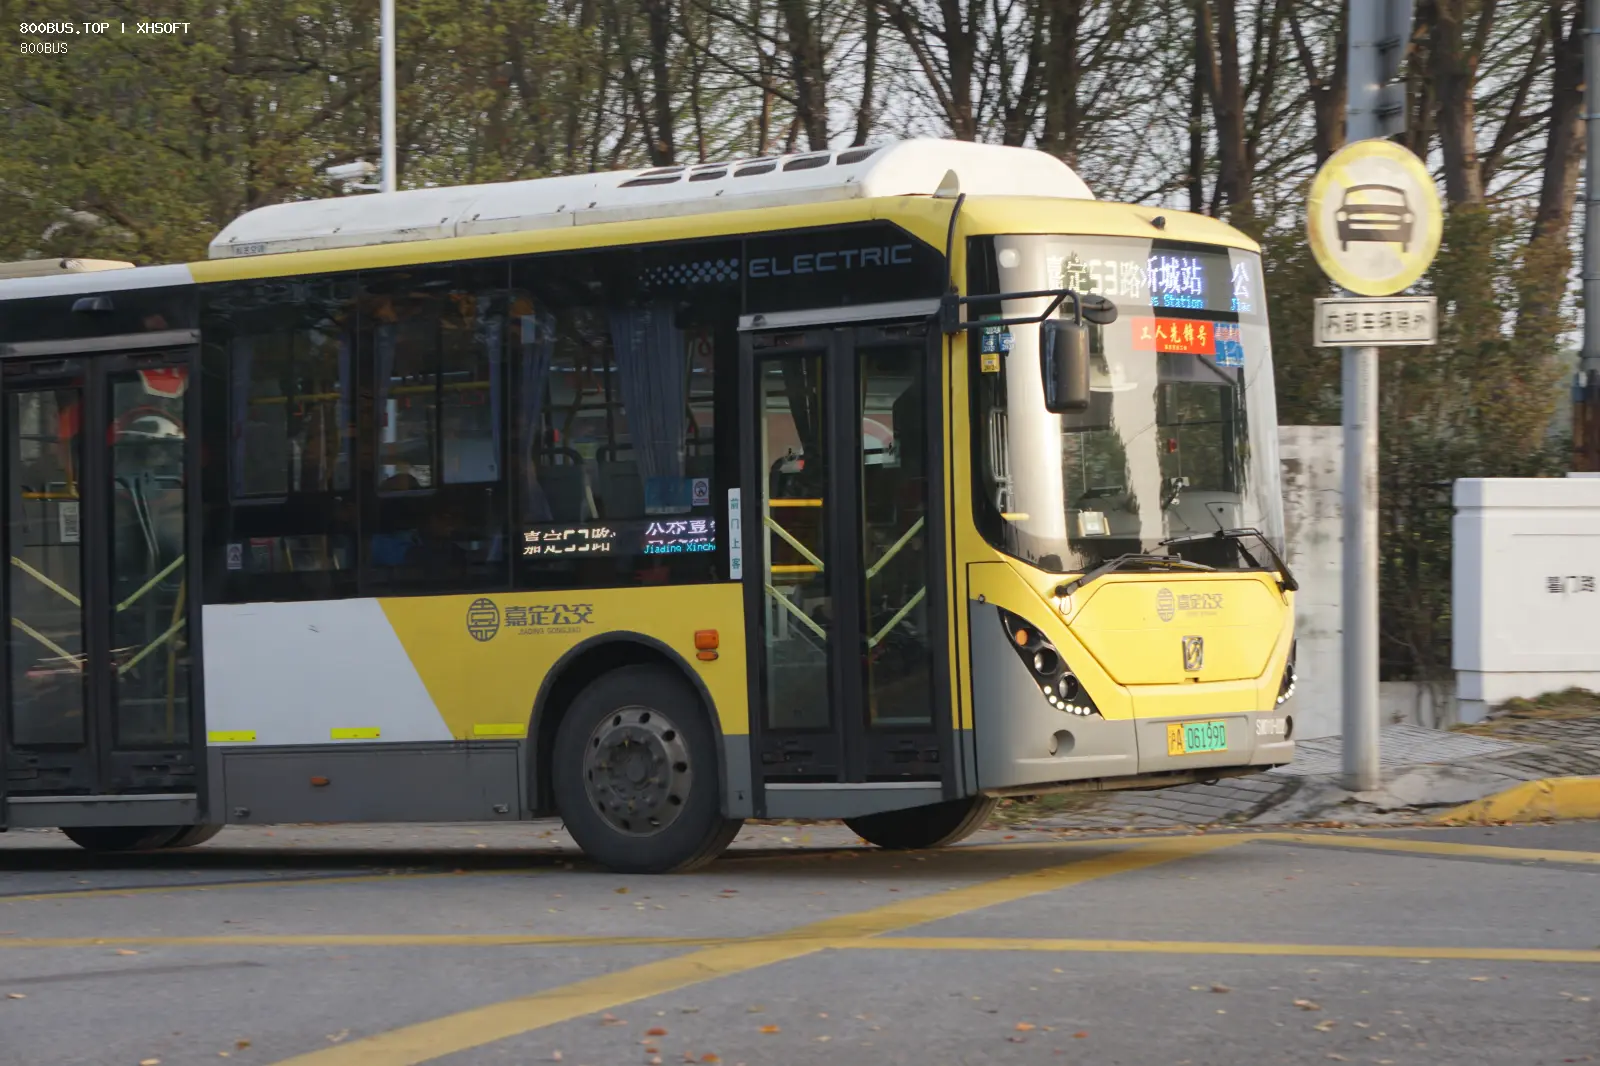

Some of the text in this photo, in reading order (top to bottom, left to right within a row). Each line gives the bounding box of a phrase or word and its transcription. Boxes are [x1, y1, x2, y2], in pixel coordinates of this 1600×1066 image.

[749, 244, 913, 278] ELECTRIC
[1140, 321, 1208, 348] 工人先锋号
[730, 497, 741, 570] 前门上客
[504, 603, 595, 627] 嘉定公交
[1177, 593, 1224, 610] 嘉定公交
